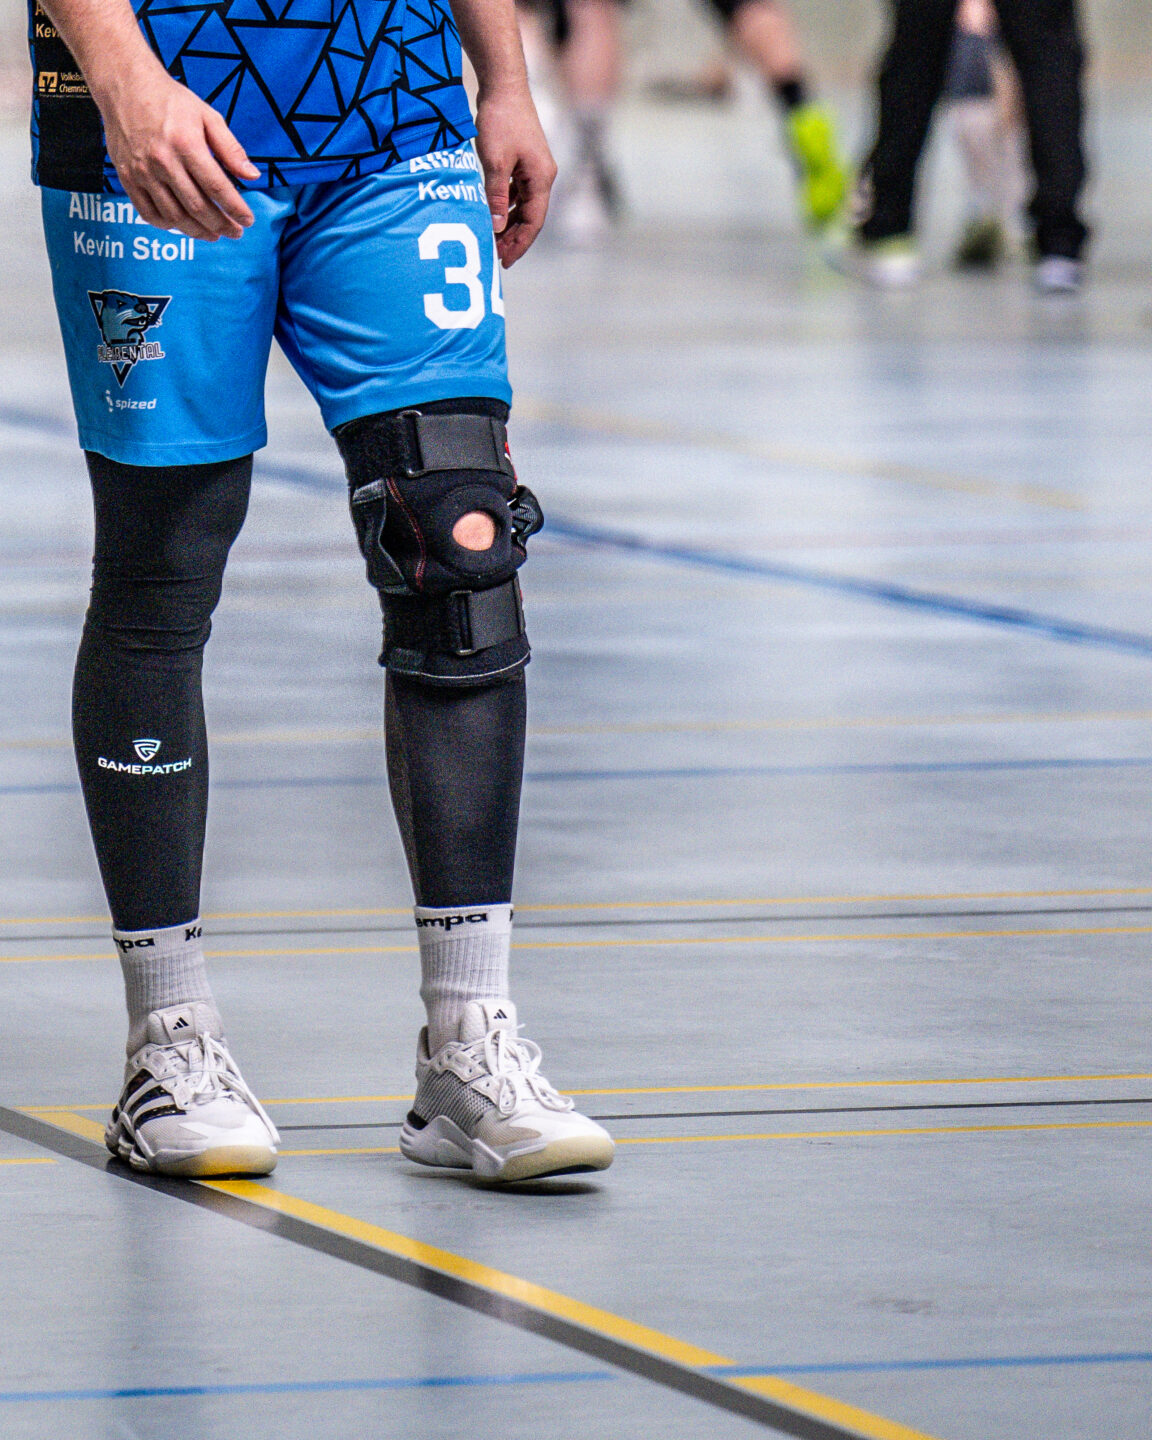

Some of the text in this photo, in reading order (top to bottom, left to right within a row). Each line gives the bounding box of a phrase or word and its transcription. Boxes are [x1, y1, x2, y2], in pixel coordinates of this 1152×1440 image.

[35, 23, 60, 38] Kev
[418, 179, 478, 202] Kevin
[73, 231, 195, 261] Kevin Stoll
[115, 398, 157, 410] spized
[97, 757, 192, 775] GAMEPATCH
[416, 913, 488, 931] empa
